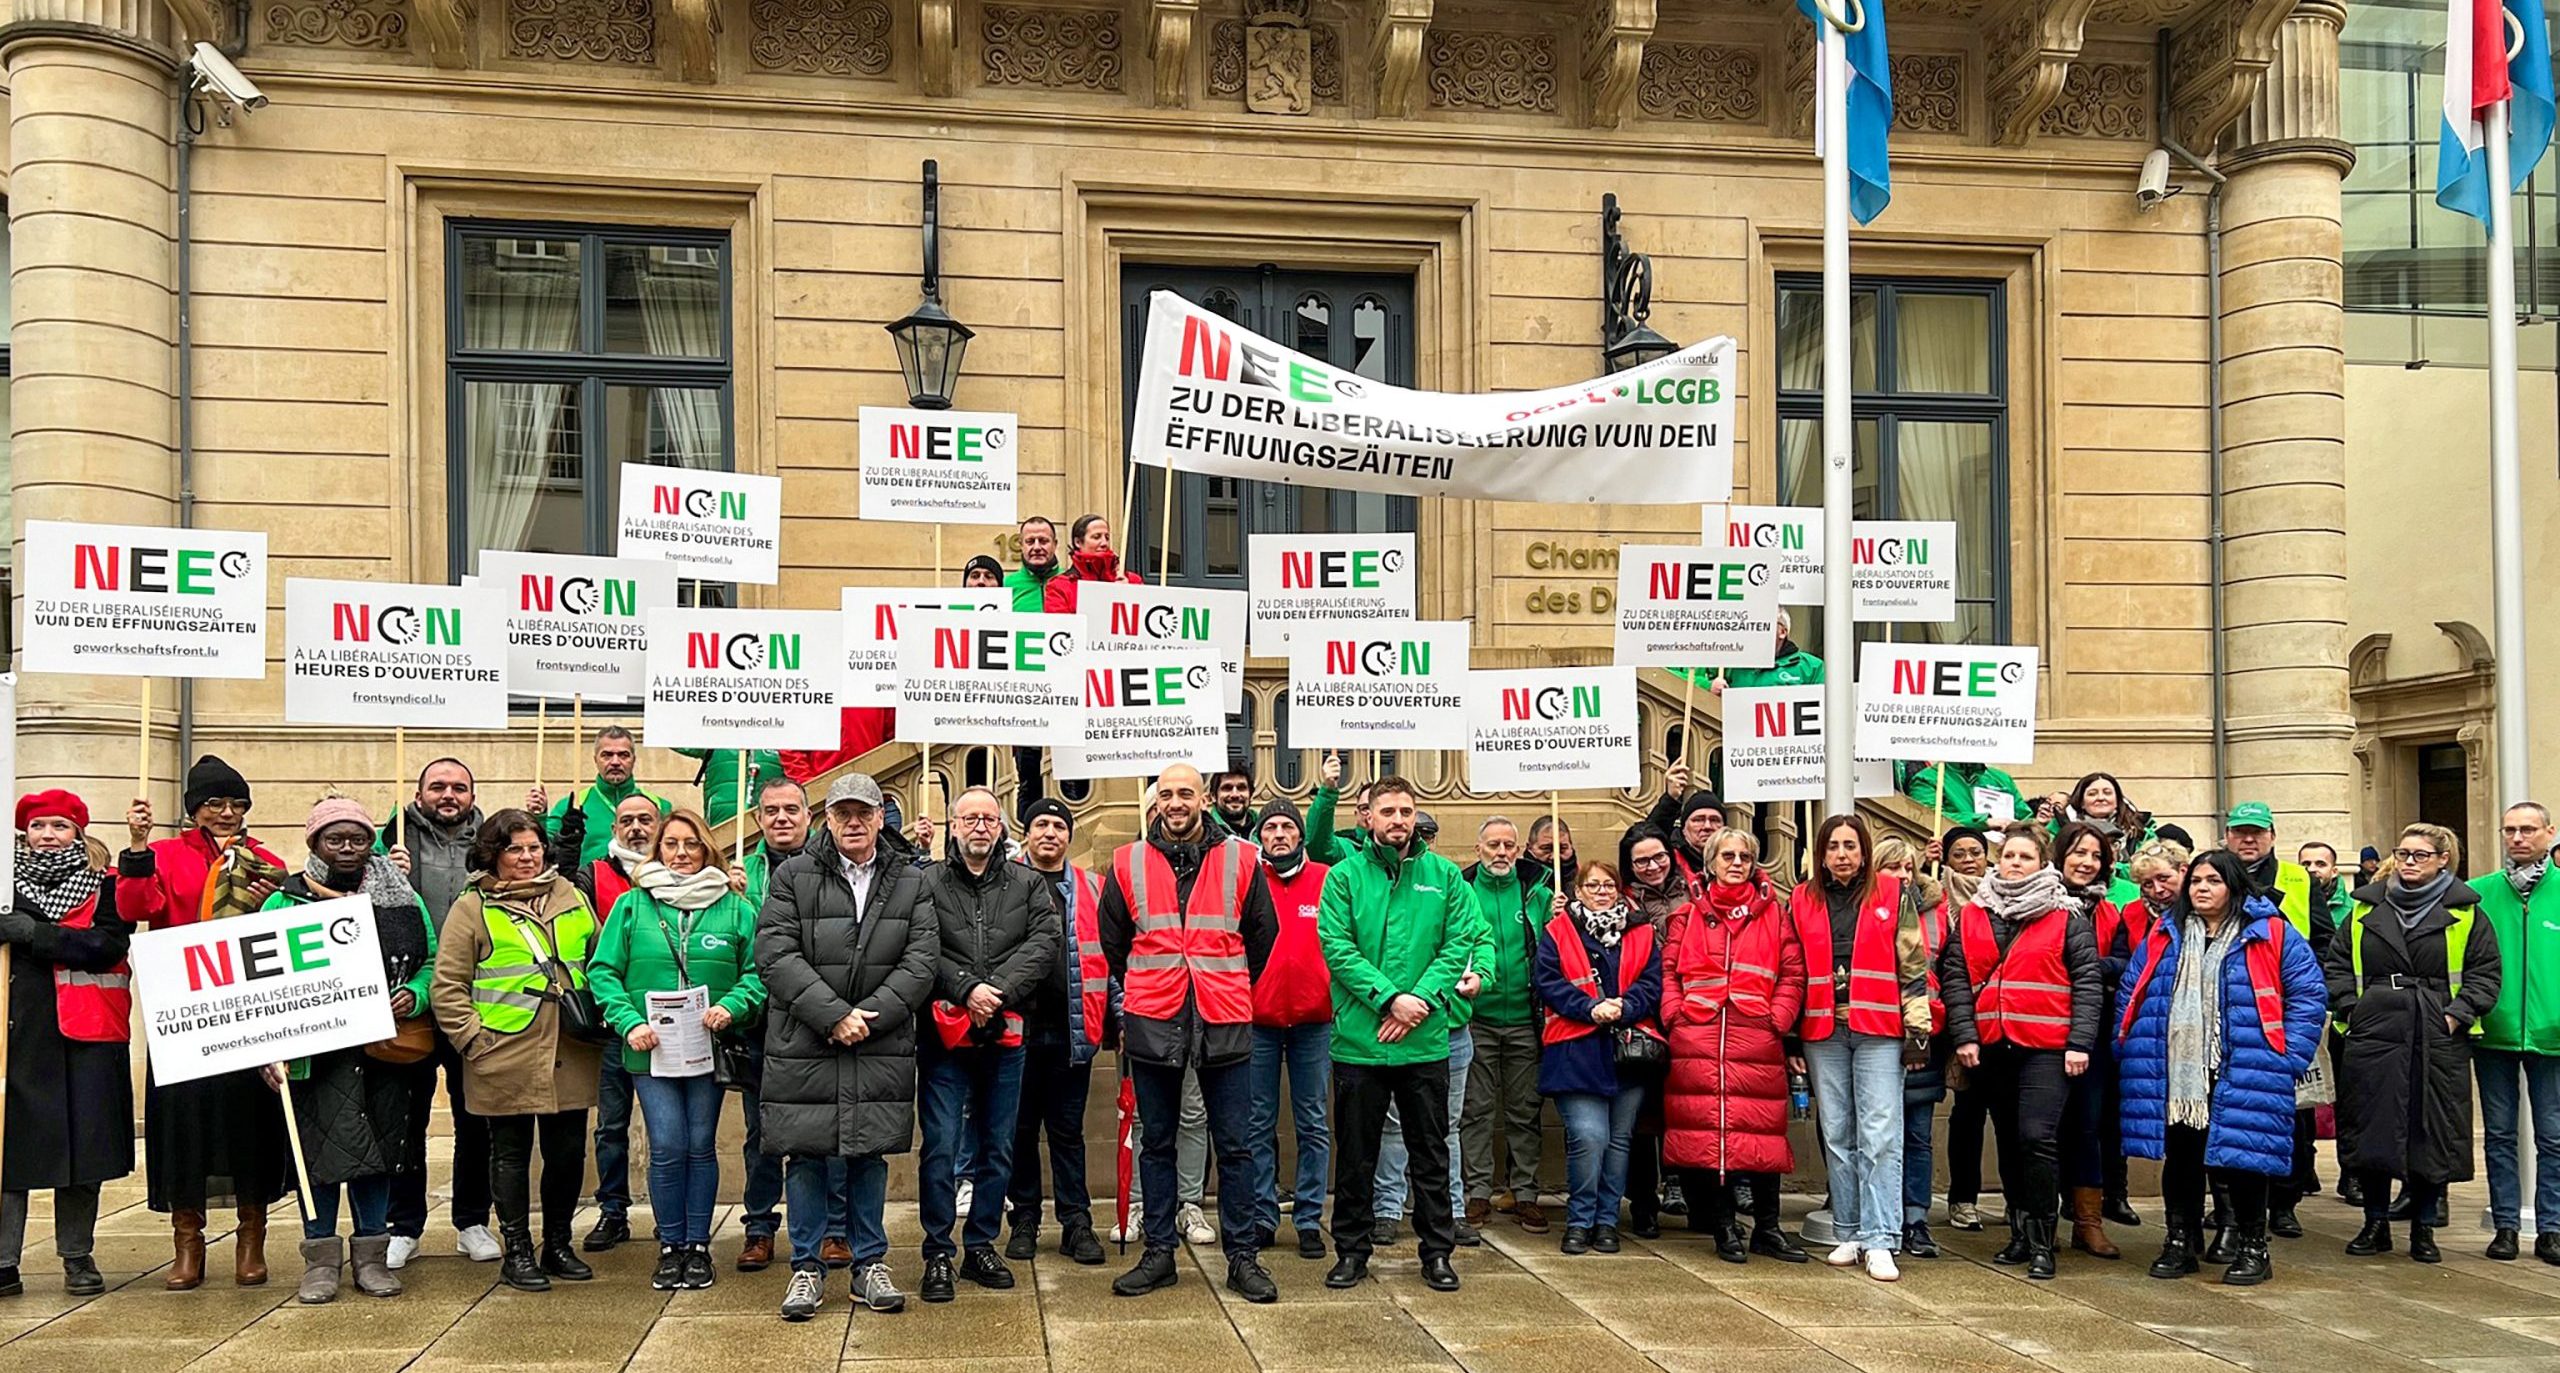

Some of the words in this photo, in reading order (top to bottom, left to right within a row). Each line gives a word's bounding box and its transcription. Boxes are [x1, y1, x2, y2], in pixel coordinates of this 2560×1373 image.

[1179, 315, 1333, 403] NEE
[1637, 378, 1720, 404] LCGB
[1170, 386, 1213, 414] ZU
[1221, 393, 1285, 425] DER
[1595, 424, 1651, 447] VUN
[1659, 423, 1716, 447] DEN
[890, 424, 983, 462] NEE
[1165, 417, 1453, 480] ËFFNUNGSZÄITEN
[865, 466, 879, 476] ZU
[882, 467, 900, 477] DER
[865, 477, 888, 486] VUN
[891, 478, 912, 487] DEN
[635, 519, 648, 528] LA
[734, 526, 753, 536] DES
[625, 529, 678, 542] HEURES
[1526, 541, 1620, 570] Cham
[74, 544, 215, 595] NEE
[1282, 551, 1380, 588] NEE
[1650, 563, 1746, 600] NEE
[36, 600, 55, 613] ZU
[60, 602, 88, 614] DER
[1257, 599, 1271, 608] ZU
[1274, 599, 1293, 608] DER
[1526, 586, 1581, 615] des
[35, 615, 68, 626] VUN
[75, 617, 107, 628] DEN
[1257, 610, 1280, 619] VUN
[1283, 610, 1306, 619] DEN
[1623, 609, 1637, 619] ZU
[1640, 610, 1660, 620] DER
[620, 624, 645, 636] DES
[1623, 621, 1645, 630] VUN
[1648, 621, 1670, 631] DEN
[509, 633, 552, 646] URES
[557, 635, 647, 650] D'OUVERTU
[849, 650, 863, 659] ZU
[866, 651, 884, 659] DER
[935, 628, 1045, 672] NEE
[310, 649, 327, 661] LA
[446, 654, 472, 666] DES
[295, 663, 369, 678] HEURES
[849, 661, 873, 670] VUN
[665, 677, 681, 687] LA
[786, 679, 809, 689] DES
[905, 678, 921, 689] ZU
[924, 680, 946, 690] DER
[1893, 660, 1997, 697] NEE
[1086, 667, 1185, 708] NEE
[1307, 683, 1320, 693] LA
[1417, 683, 1438, 693] DES
[653, 690, 718, 702] HEURES
[904, 691, 931, 701] VUN
[935, 693, 960, 703] DEN
[1296, 695, 1354, 706] HEURES
[1865, 703, 1880, 712] ZU
[1883, 704, 1903, 713] DER
[1754, 700, 1821, 738] NE
[1864, 715, 1888, 723] VUN
[1892, 716, 1915, 725] DEN
[1486, 728, 1498, 738] LA
[1589, 724, 1609, 735] DES
[1475, 739, 1531, 751] HEURES
[1730, 748, 1744, 757] ZU
[1747, 747, 1766, 756] DER
[1730, 758, 1754, 767] VUN
[1757, 758, 1780, 766] DEN
[183, 923, 330, 992] NEE
[156, 1010, 176, 1023] ZU
[180, 1002, 210, 1019] DER
[157, 1020, 193, 1037] VUN
[197, 1013, 231, 1030] DEN
